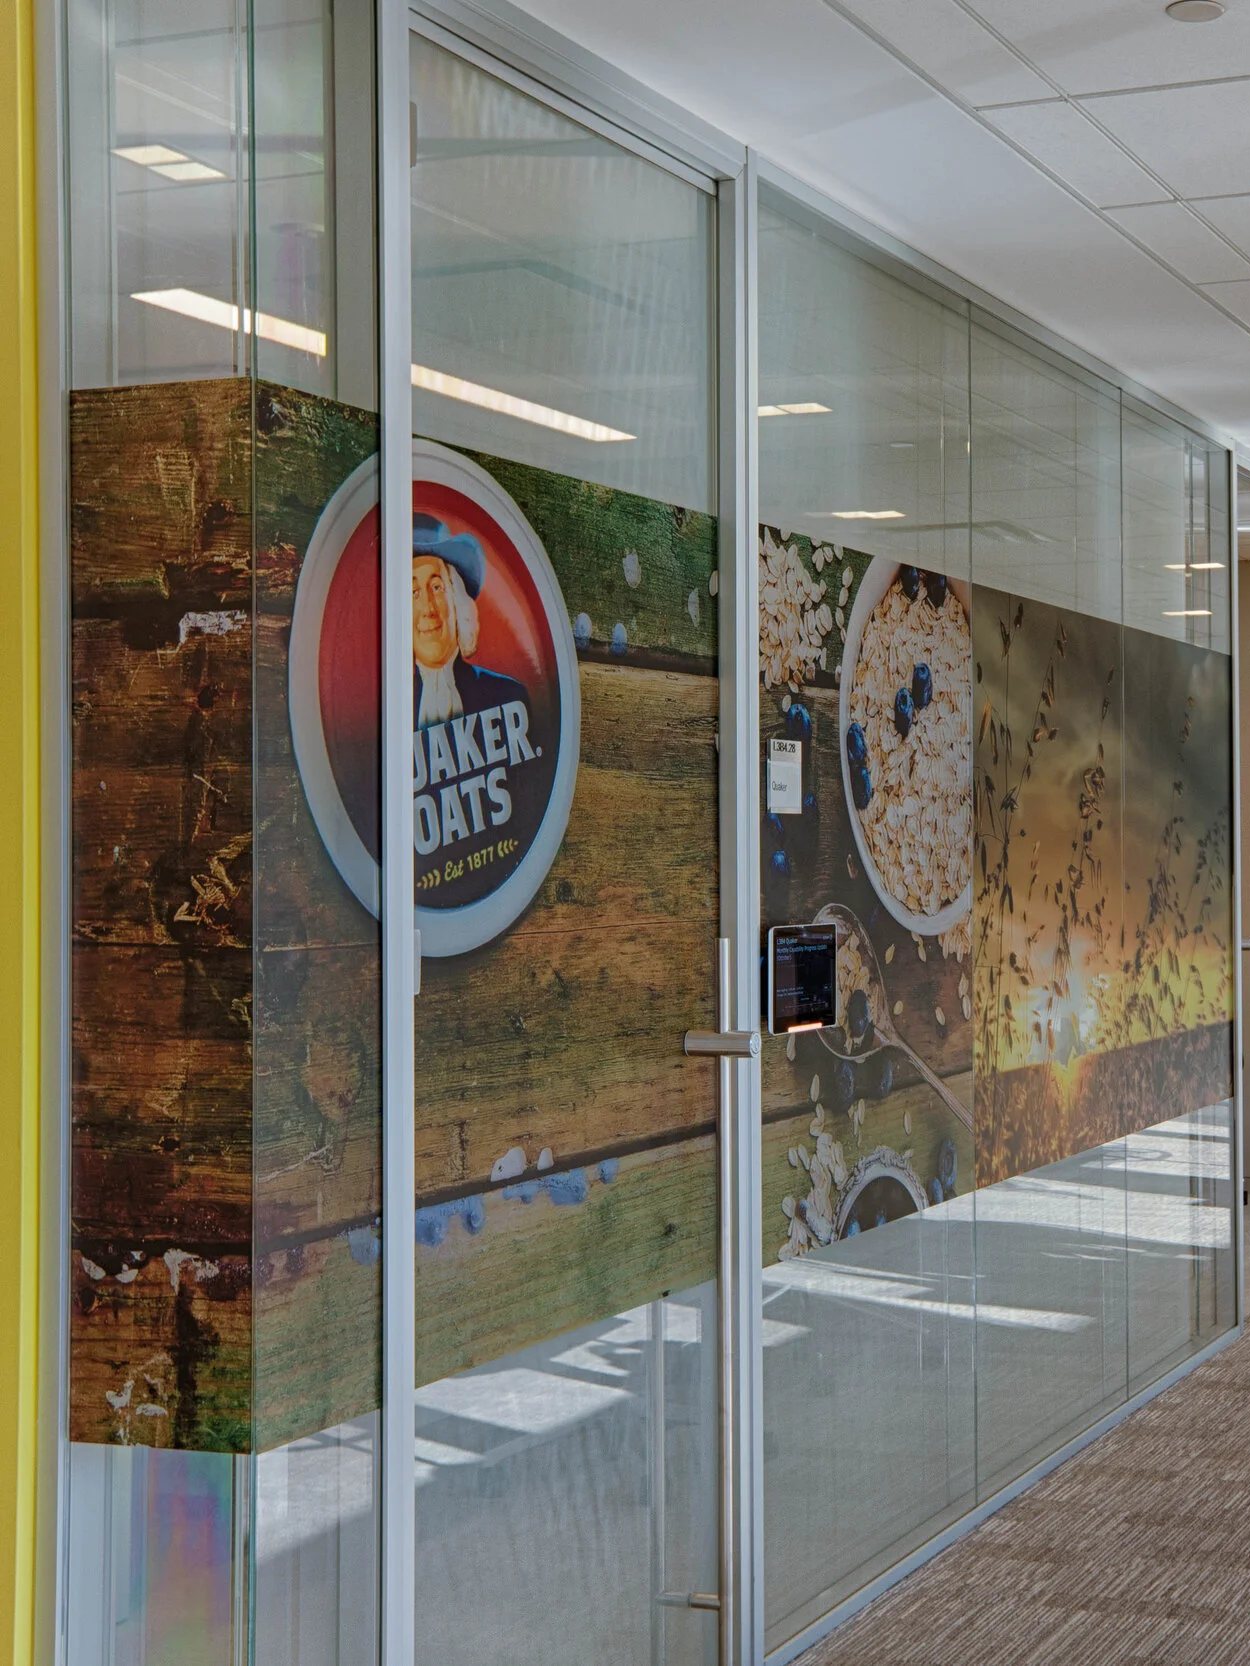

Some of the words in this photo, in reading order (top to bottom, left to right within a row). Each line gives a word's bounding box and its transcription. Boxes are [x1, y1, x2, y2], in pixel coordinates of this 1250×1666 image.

[413, 766, 512, 856] OATS
[444, 860, 465, 882] Est
[467, 847, 495, 873] 1877
